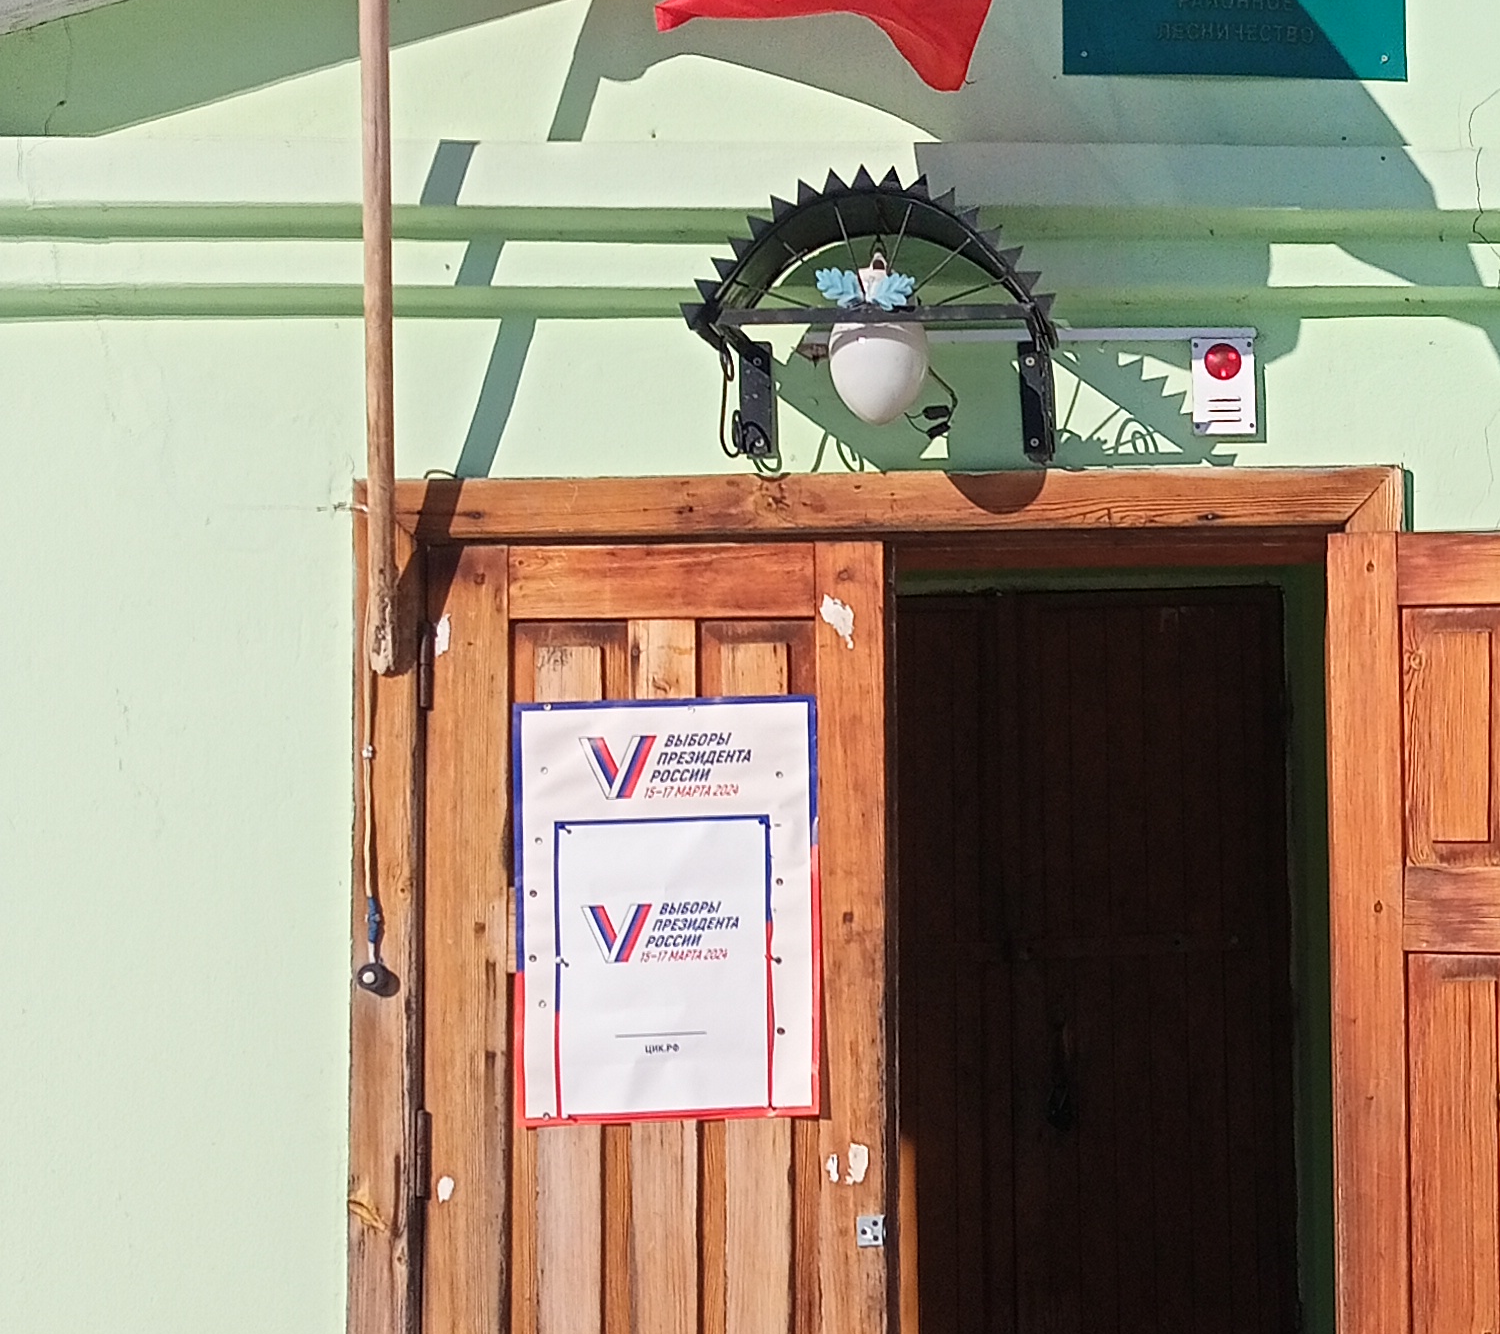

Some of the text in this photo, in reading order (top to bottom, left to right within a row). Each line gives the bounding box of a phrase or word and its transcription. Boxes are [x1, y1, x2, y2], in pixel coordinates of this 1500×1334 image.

[1156, 21, 1317, 44] ЛЕСНИЧЕСТВО
[664, 732, 732, 748] ВЫБОРЫ
[656, 749, 752, 766] ПРЕЗИДЕНТА
[649, 767, 711, 783] РОССИИ
[674, 784, 712, 798] МАРТА
[713, 783, 739, 797] 2024
[659, 901, 722, 916] ВЫБОРЫ
[652, 916, 740, 932] ПРЕЗИДЕНТА
[645, 933, 702, 948] РОССИИ
[668, 949, 703, 962] МАРТА
[704, 948, 728, 960] 2024
[645, 1043, 680, 1054] ЦИК.РФ
